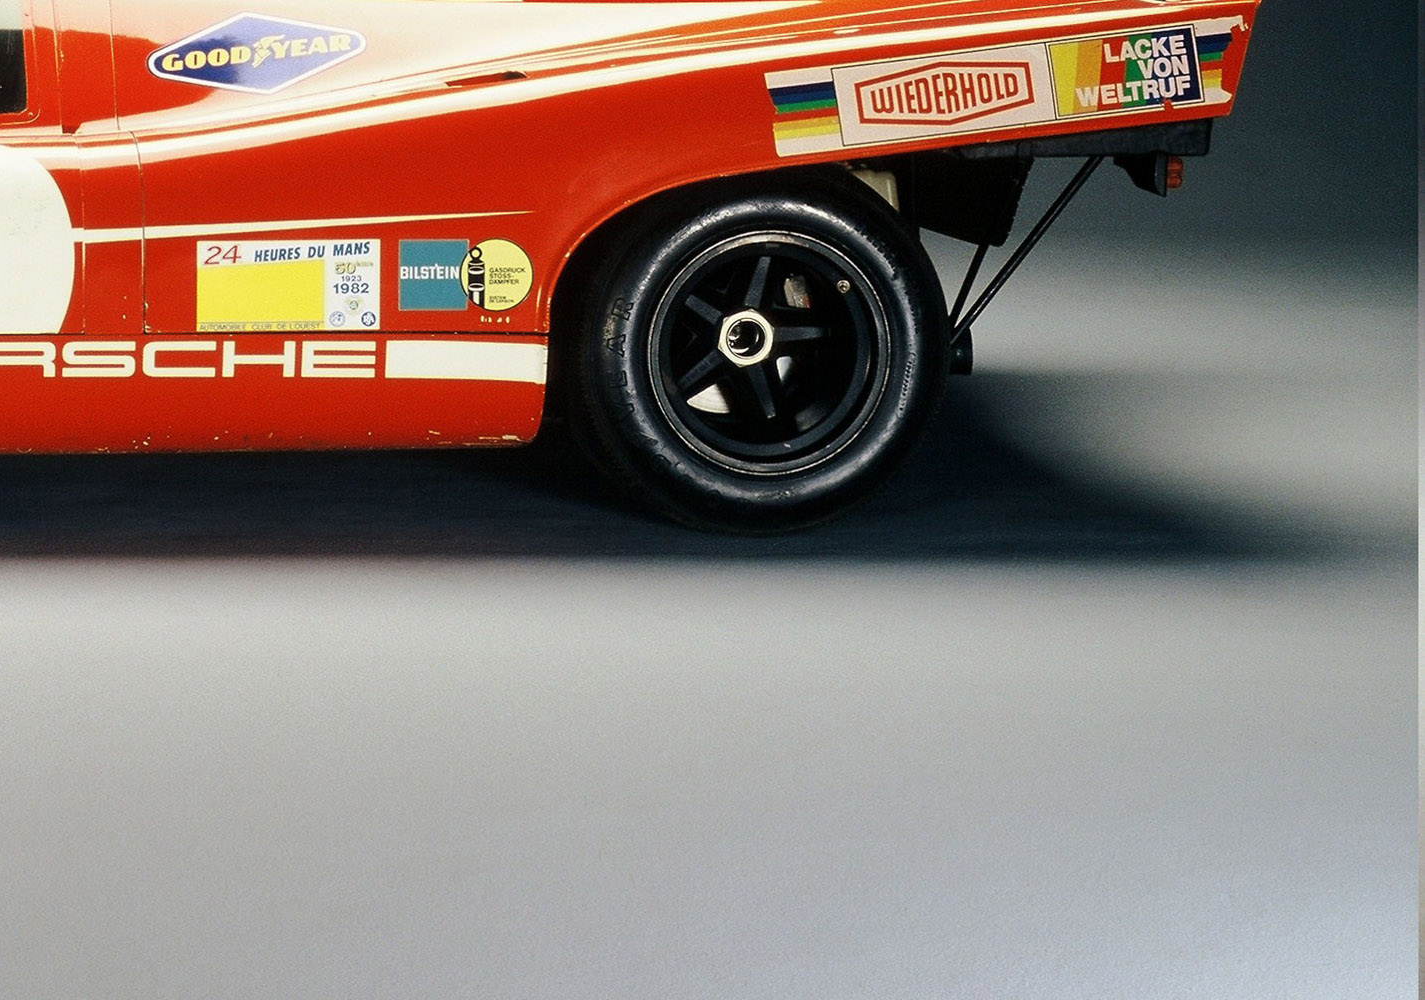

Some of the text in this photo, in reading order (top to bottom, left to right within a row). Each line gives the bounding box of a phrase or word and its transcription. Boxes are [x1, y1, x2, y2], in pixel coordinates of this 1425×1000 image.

[1103, 35, 1187, 64] LACKE
[1136, 54, 1190, 78] VON
[869, 72, 1020, 115] WIEDERHOLD
[1074, 75, 1191, 109] WELTRUF
[204, 241, 371, 266] 24 HEURES DU MANS
[400, 264, 460, 280] BILSTEIN
[333, 283, 369, 294] 1982
